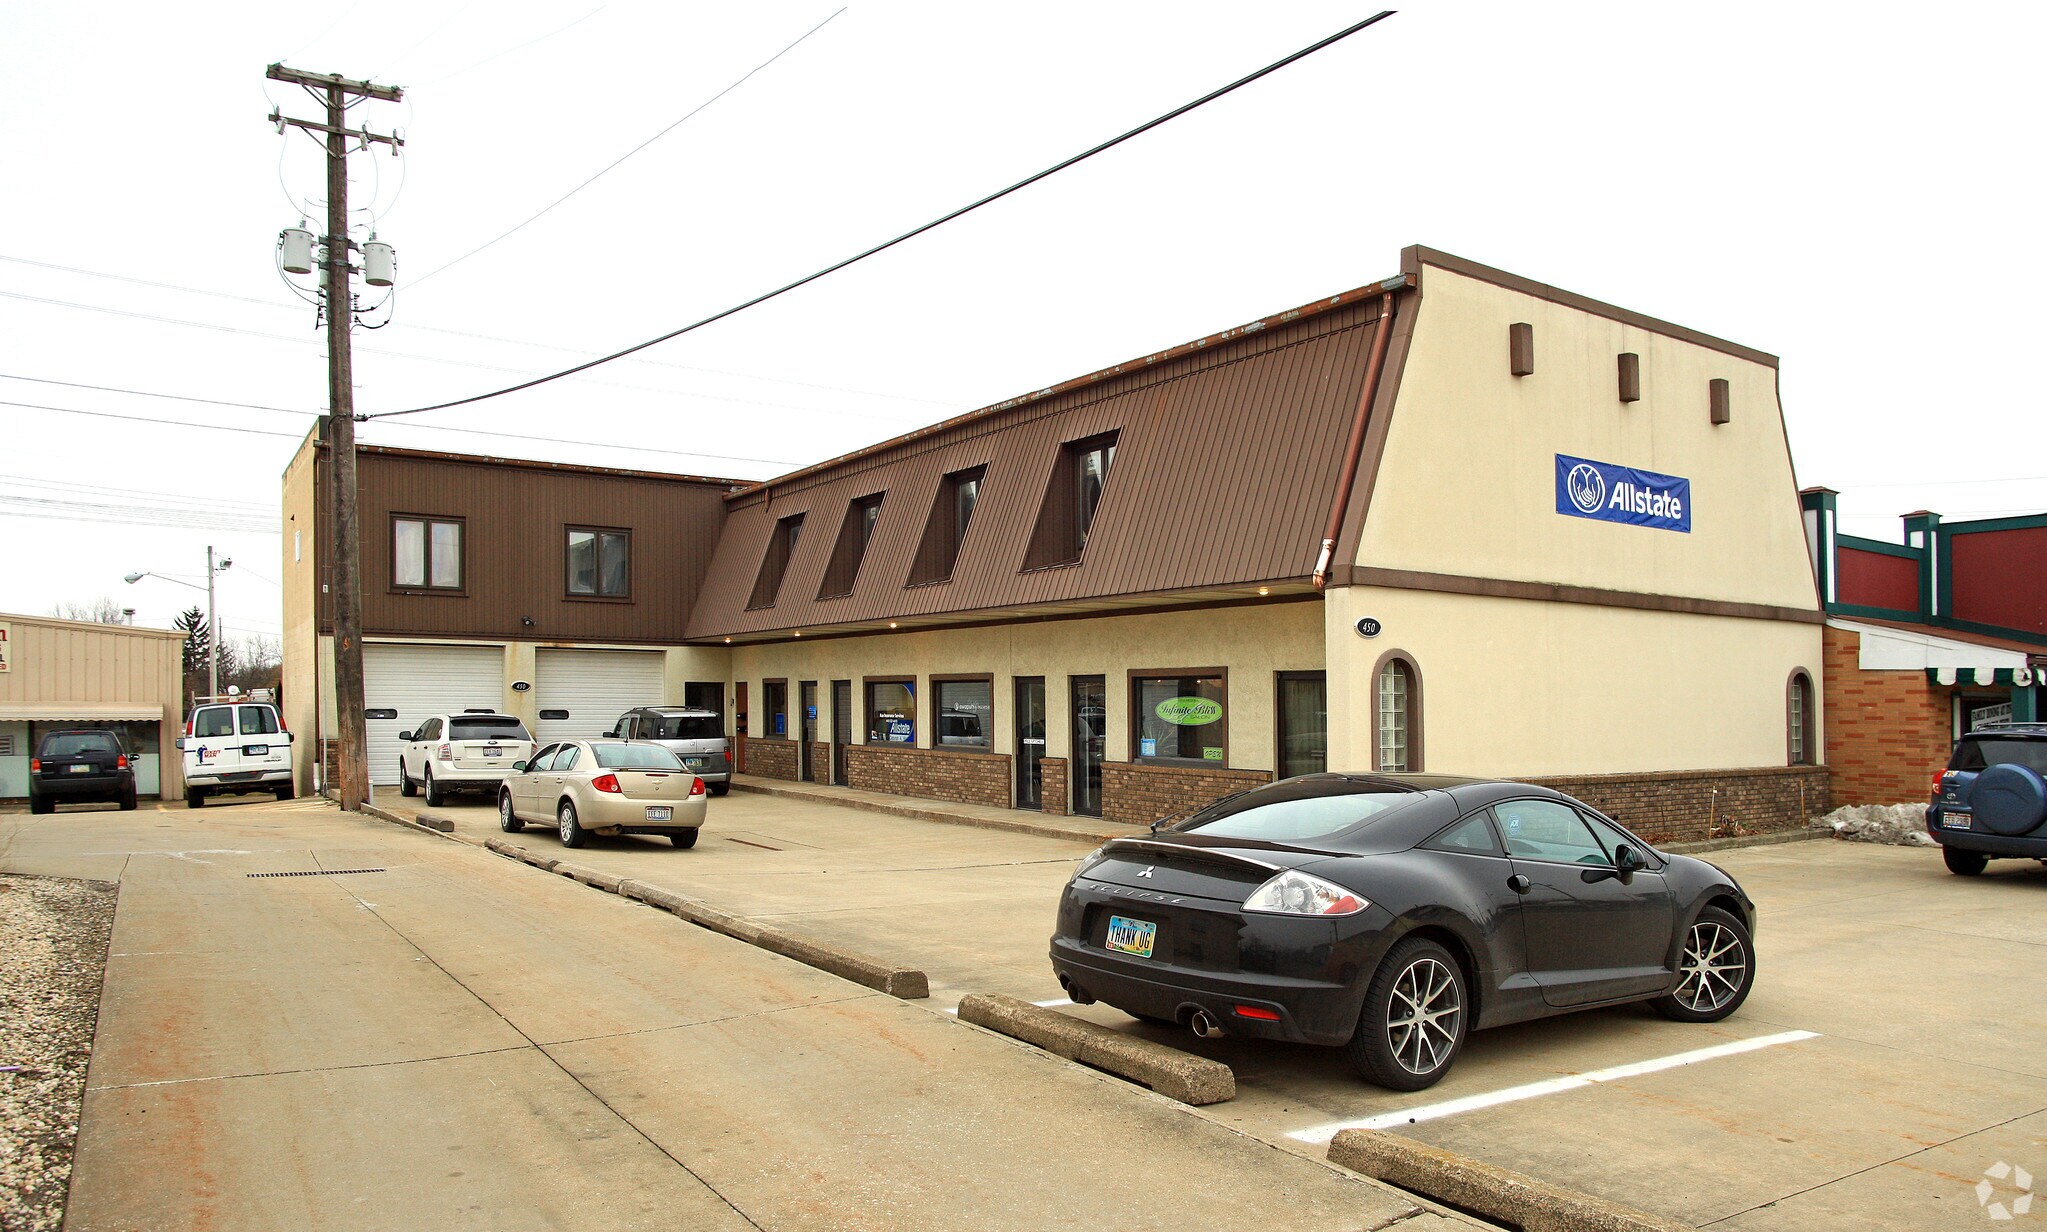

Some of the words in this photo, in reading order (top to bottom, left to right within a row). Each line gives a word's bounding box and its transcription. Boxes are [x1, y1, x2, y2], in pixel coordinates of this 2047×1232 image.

[1608, 481, 1682, 520] Allstate
[1362, 622, 1376, 633] 450
[1161, 704, 1192, 716] Infinite
[1204, 750, 1222, 758] OPEN
[1089, 884, 1188, 904] ECLIPSE
[1110, 925, 1138, 946] THANK
[1139, 931, 1151, 949] UG
